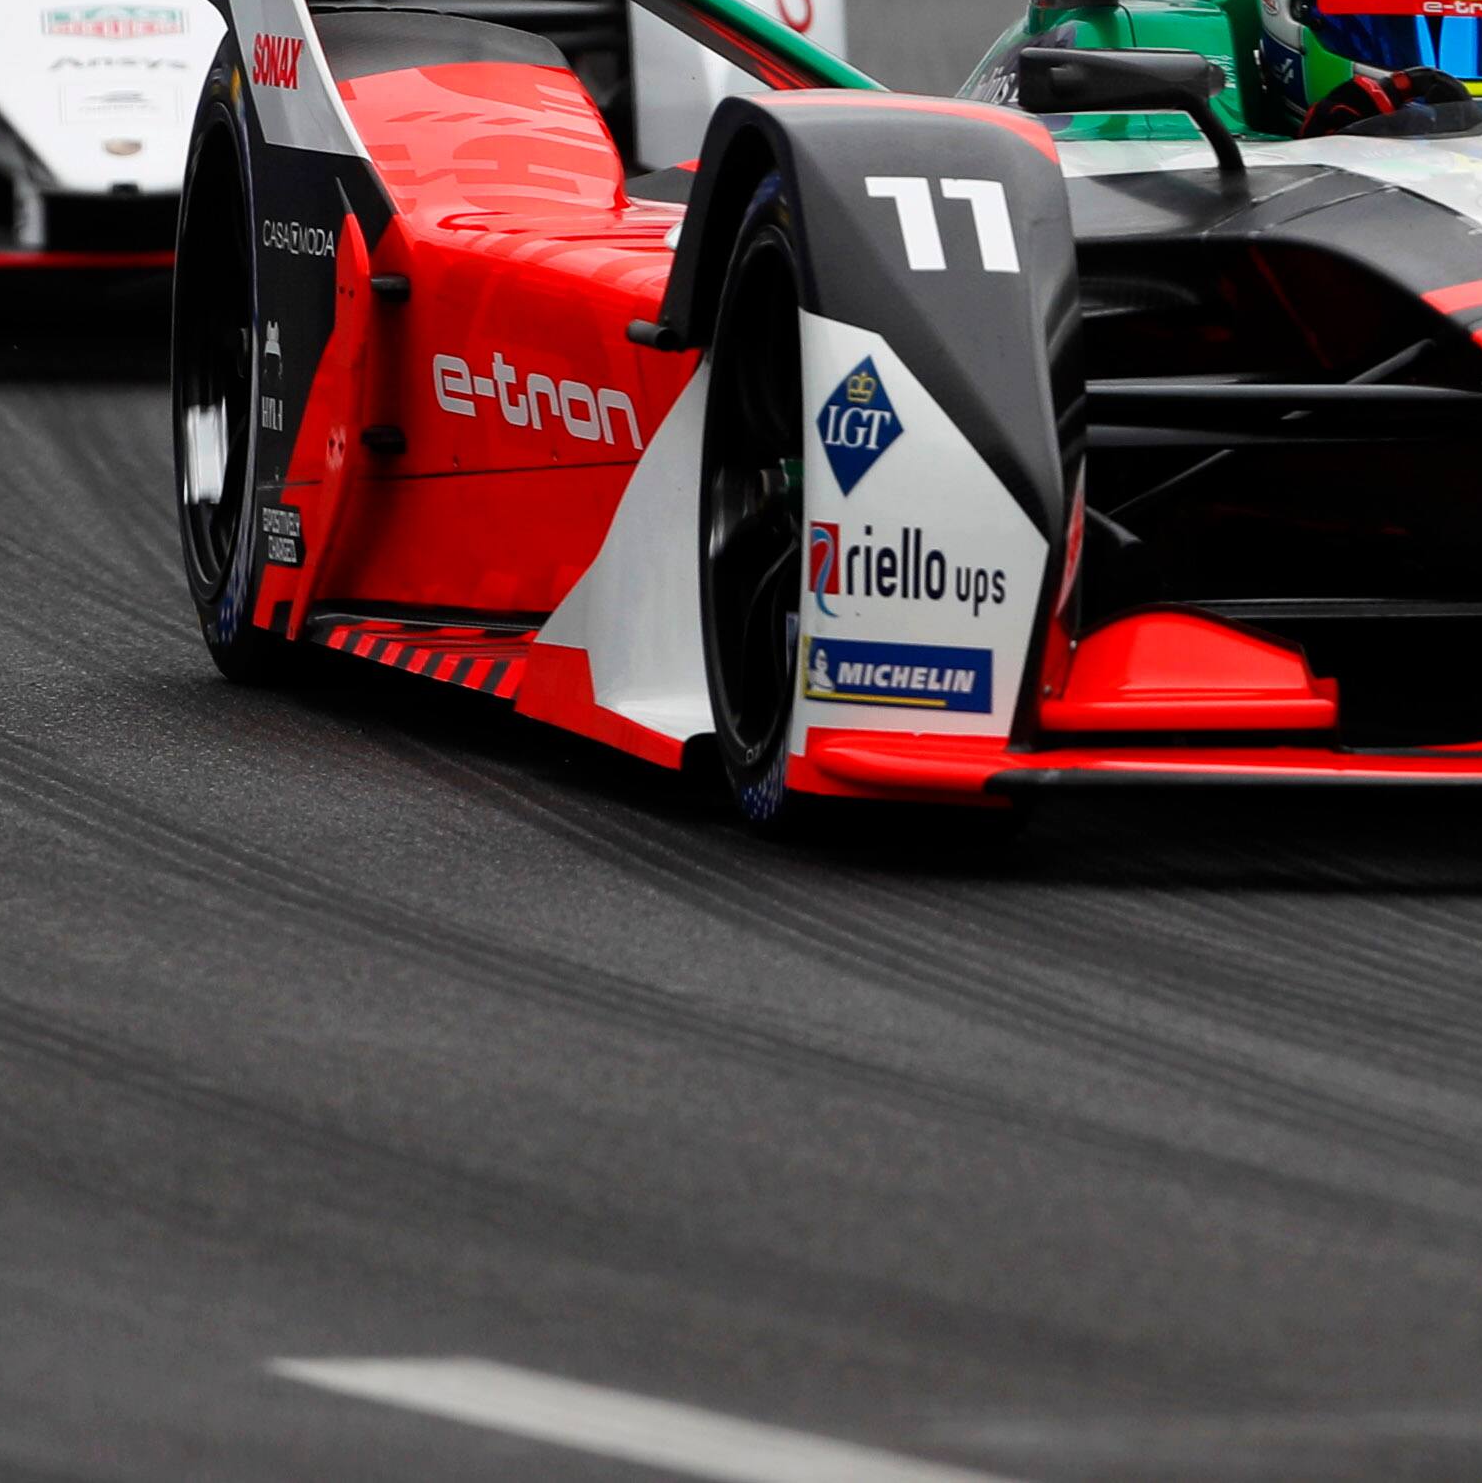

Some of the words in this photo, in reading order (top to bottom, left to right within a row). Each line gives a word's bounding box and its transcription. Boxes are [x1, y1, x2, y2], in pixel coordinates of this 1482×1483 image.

[252, 32, 304, 90] SONAX
[864, 176, 1021, 274] 11
[432, 351, 644, 451] e-tron
[825, 404, 892, 450] LGT
[845, 524, 947, 601] riello
[955, 566, 1007, 618] ups
[837, 662, 976, 694] MICHELIN
